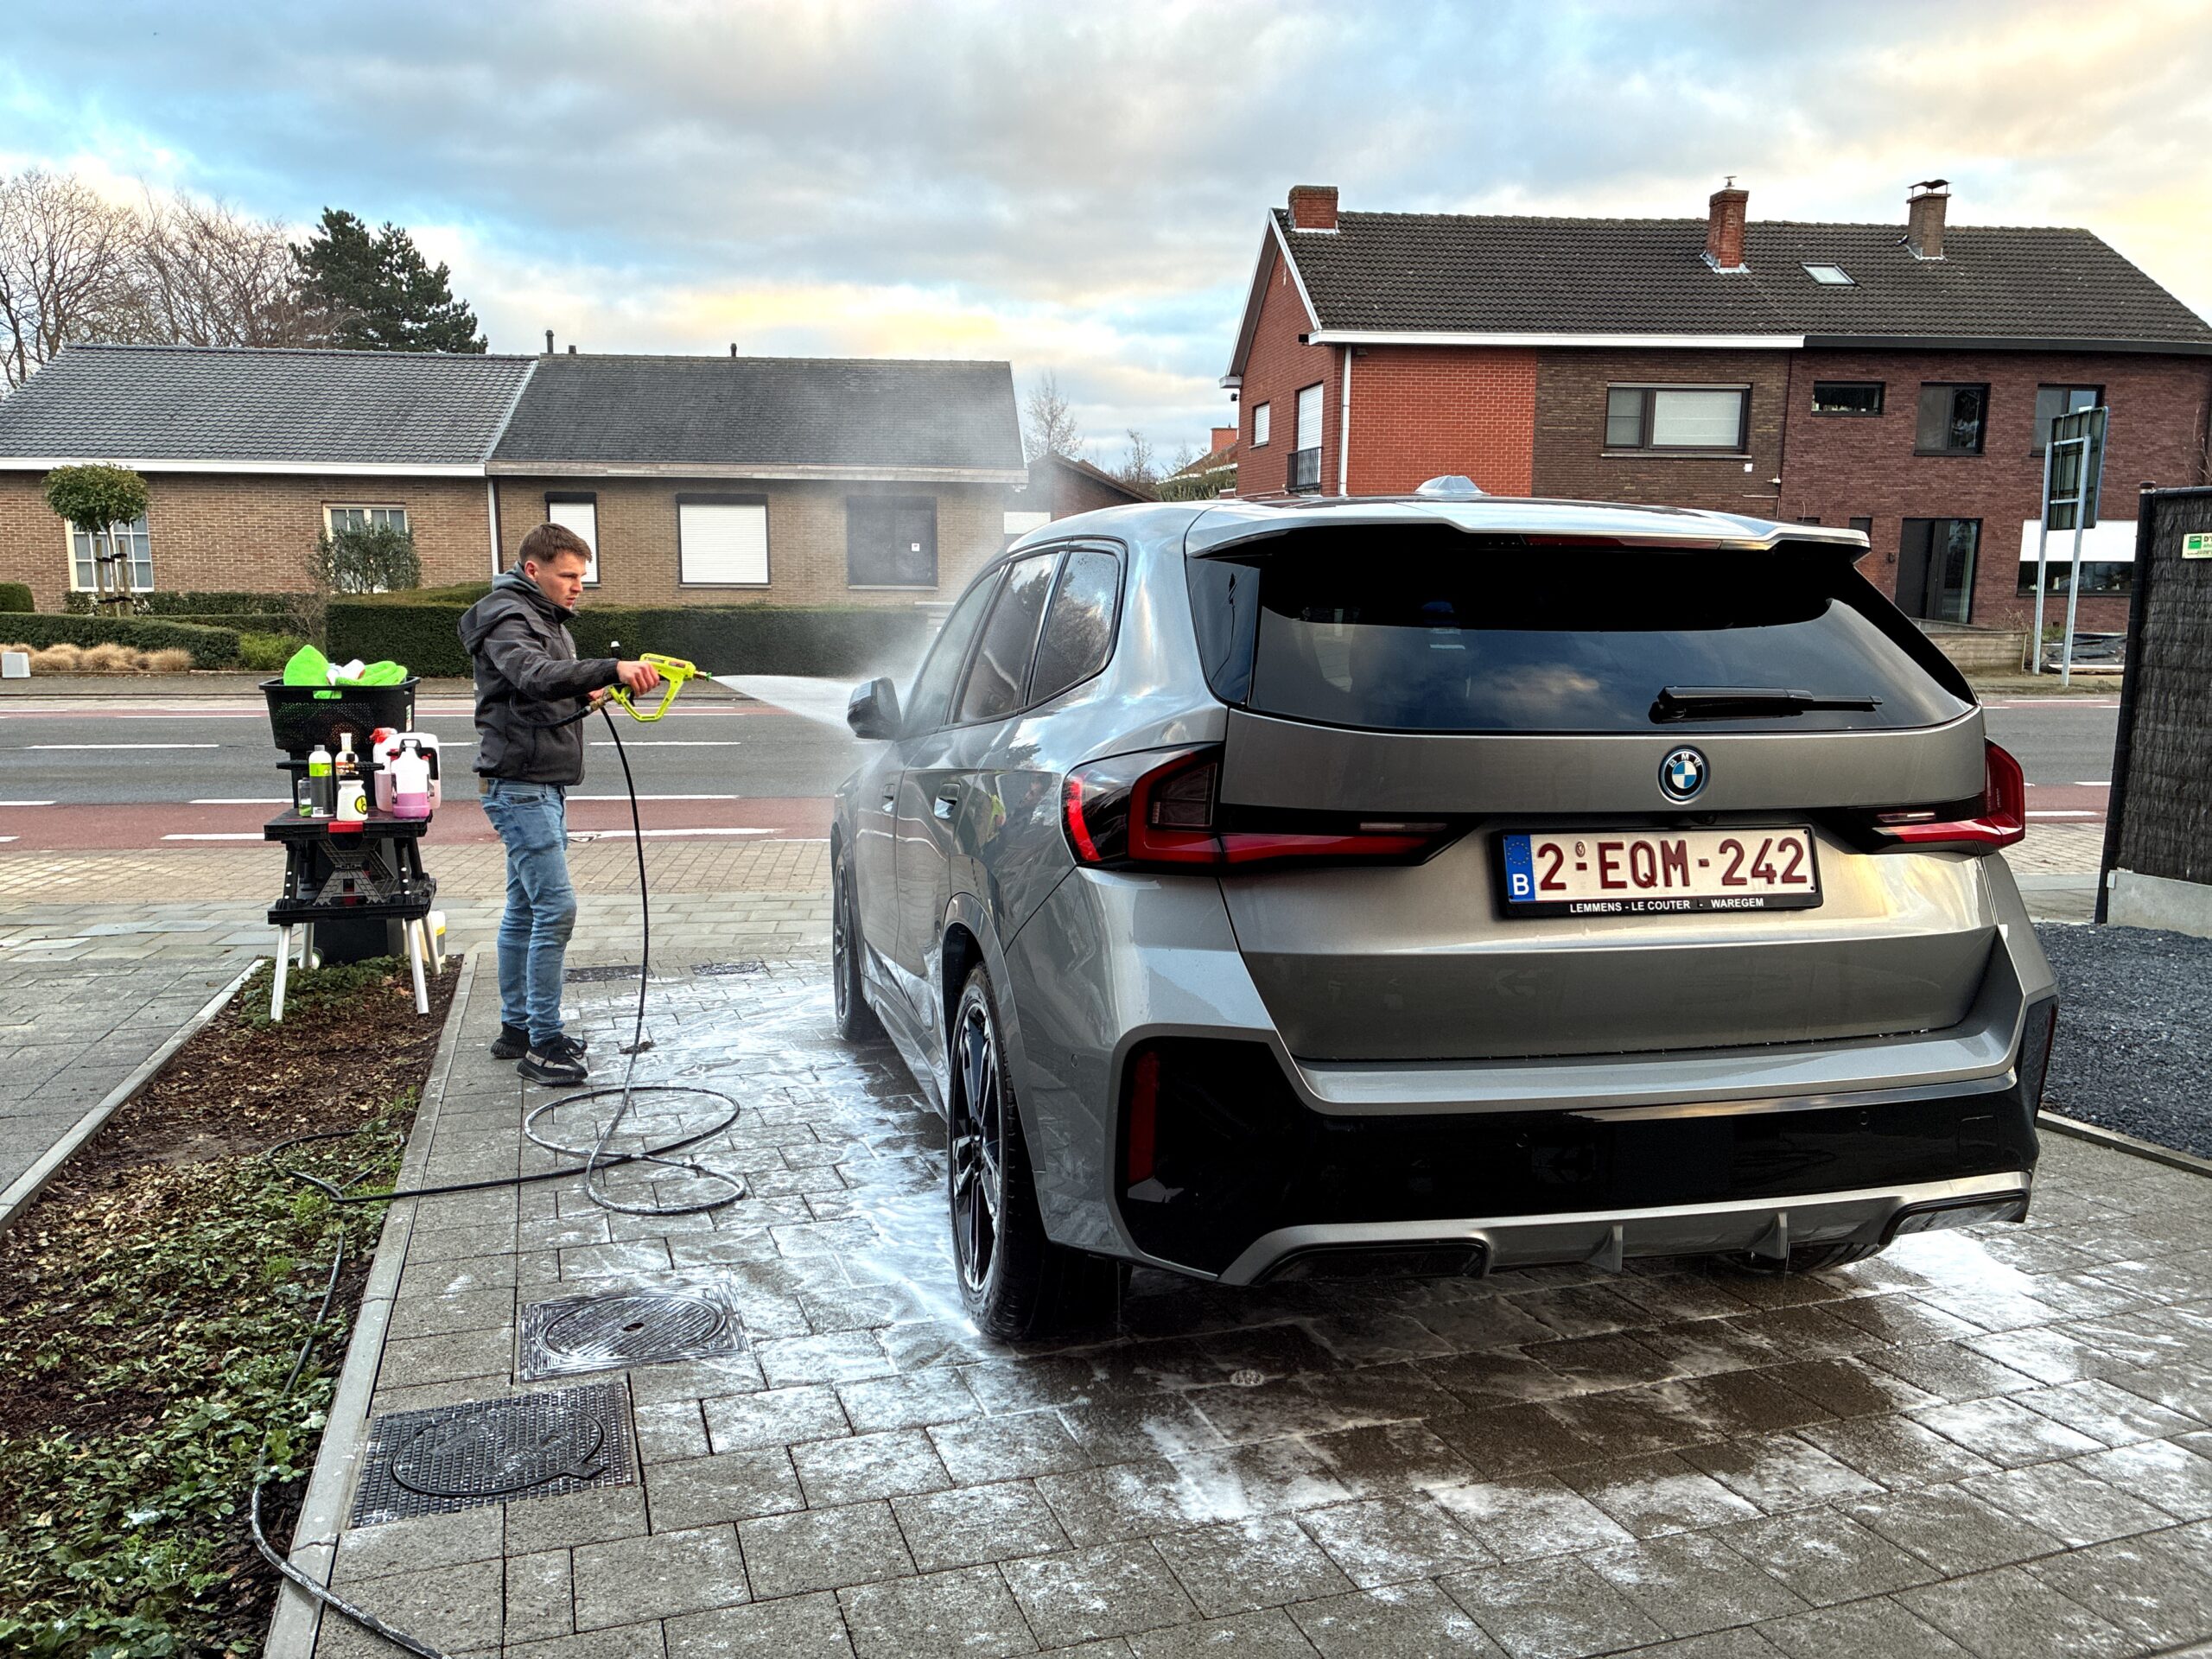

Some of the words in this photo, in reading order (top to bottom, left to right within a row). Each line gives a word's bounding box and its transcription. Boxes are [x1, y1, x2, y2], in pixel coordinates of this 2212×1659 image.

[1669, 753, 1701, 767] BMW
[1512, 874, 1529, 895] B
[1570, 902, 1622, 912] LEMMENS
[1631, 902, 1644, 912] LE
[1647, 900, 1691, 911] COUTER
[1711, 898, 1764, 908] WAREGEM
